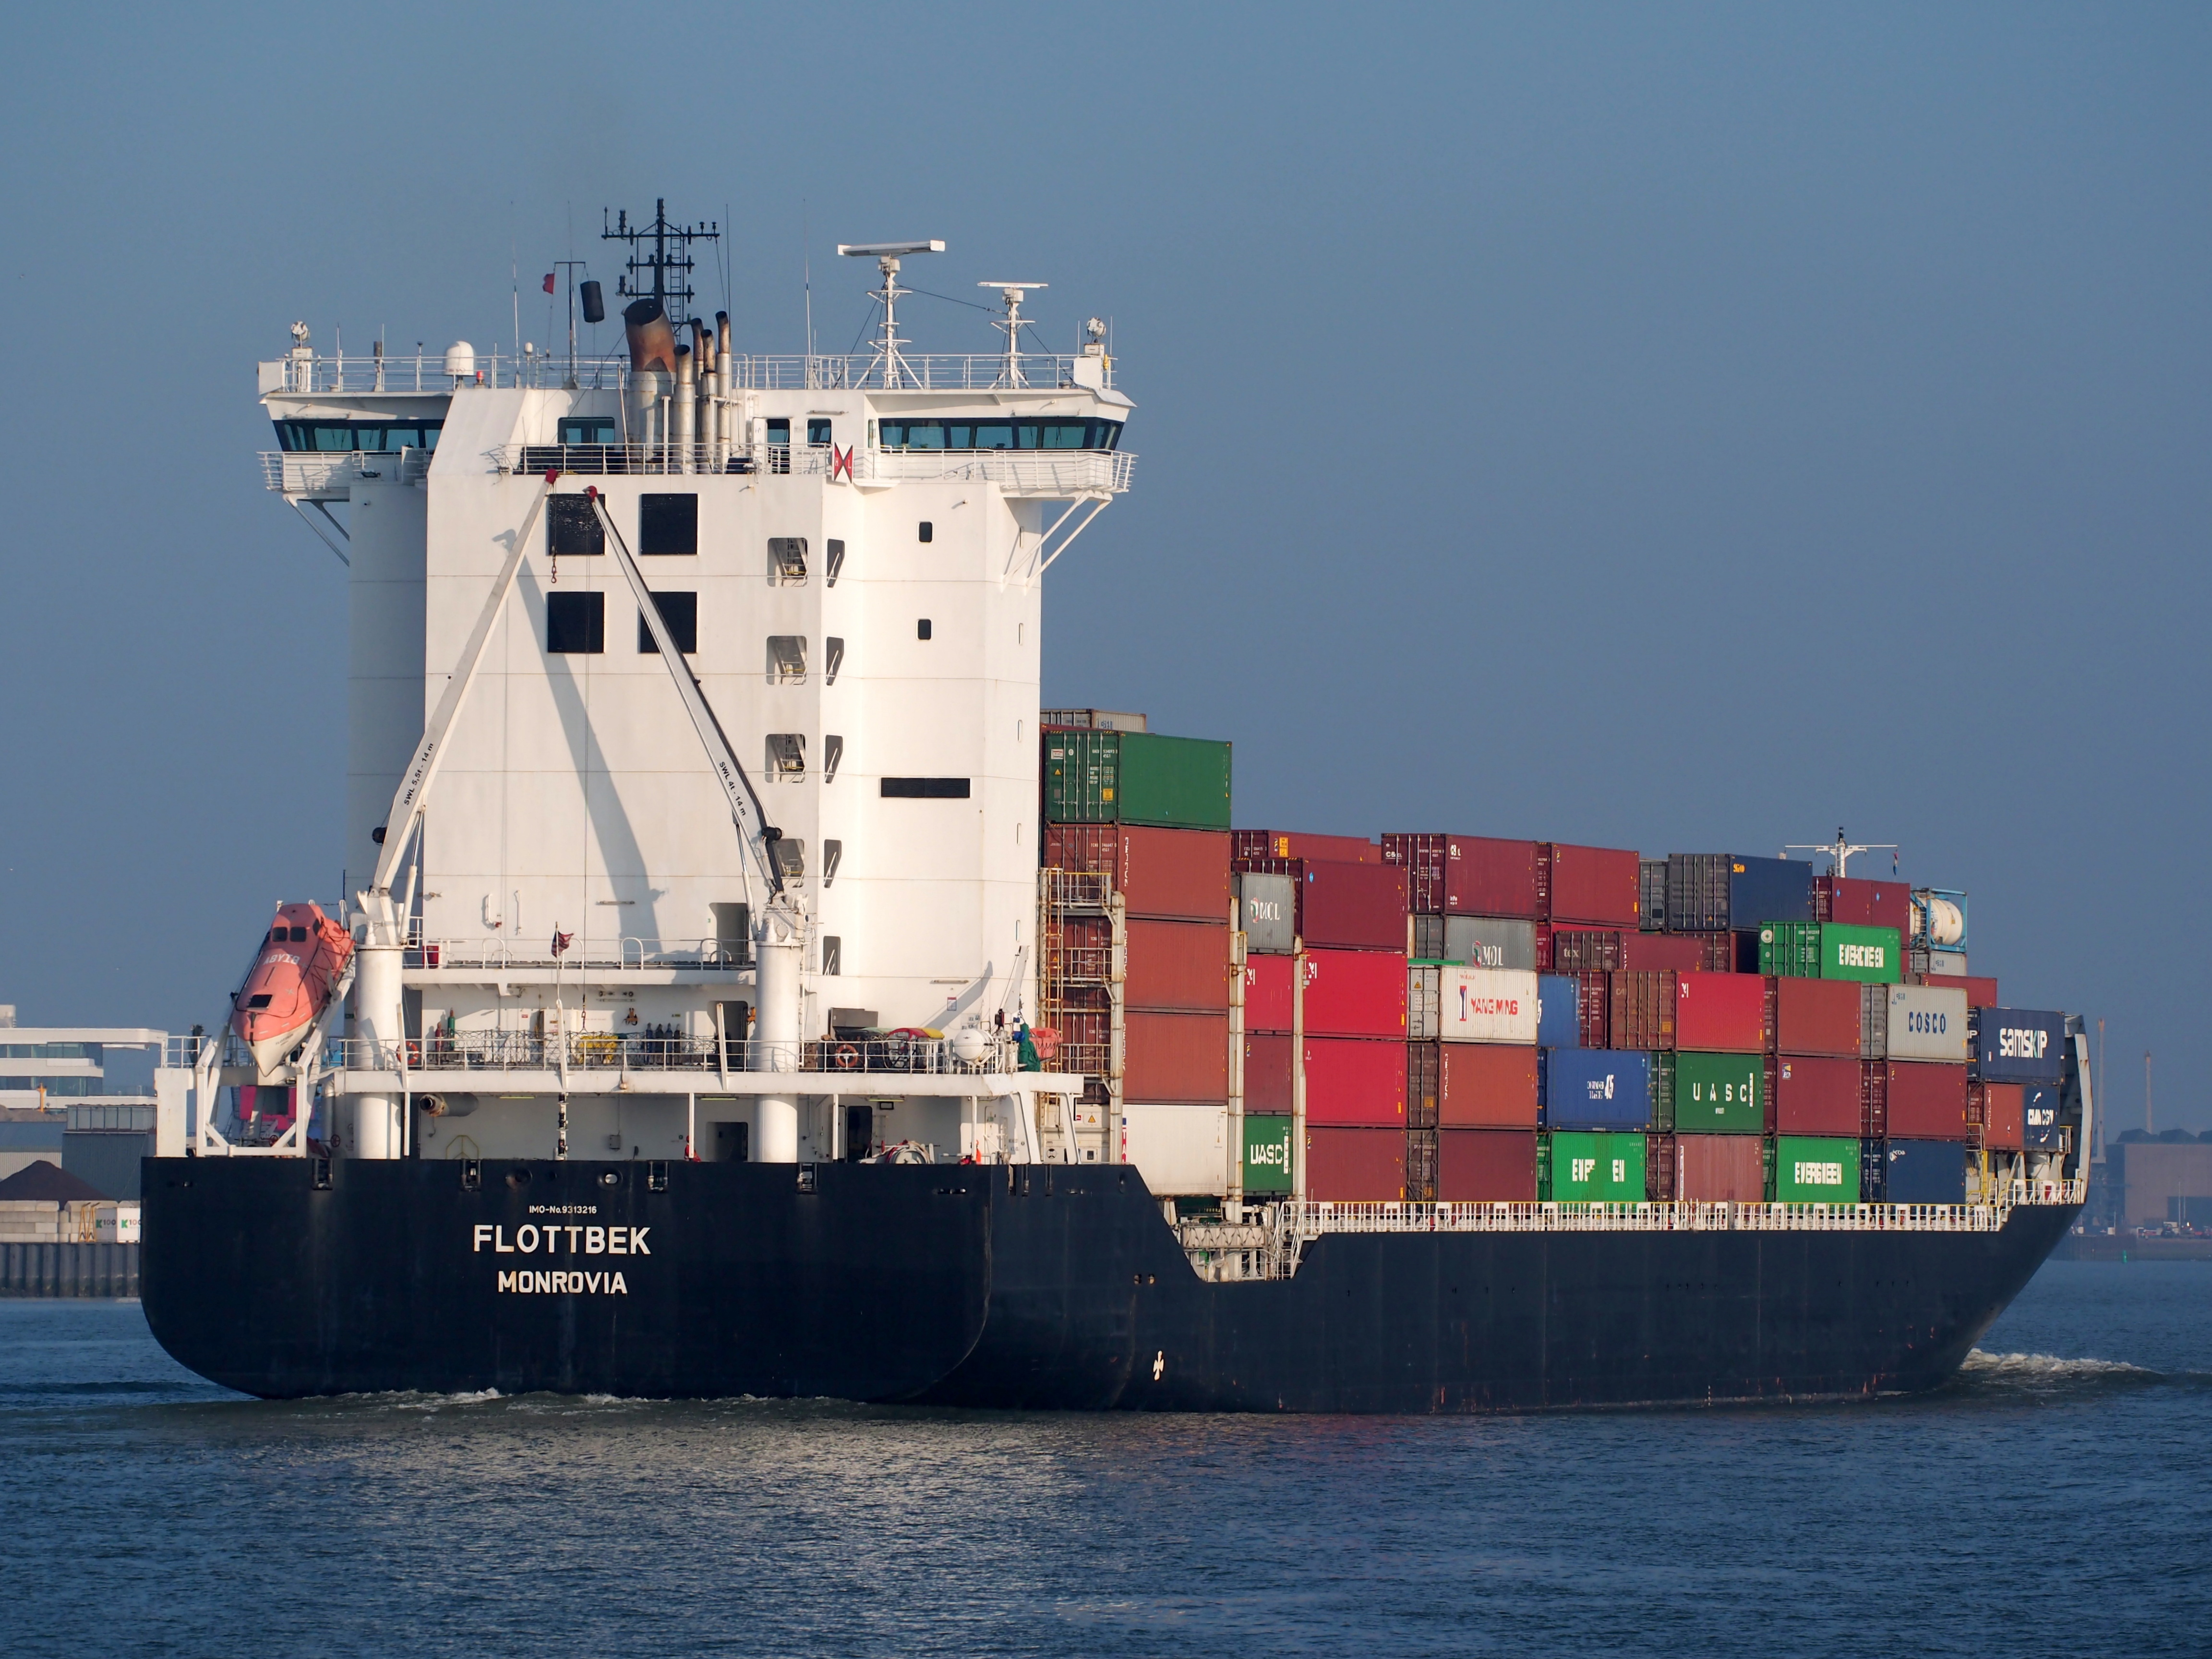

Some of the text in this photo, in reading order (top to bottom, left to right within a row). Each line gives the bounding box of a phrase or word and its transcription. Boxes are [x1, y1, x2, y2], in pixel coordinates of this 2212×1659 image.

[404, 788, 414, 805] SWL
[412, 769, 422, 785] 5,5t
[422, 753, 429, 761] 14
[428, 743, 433, 751] m
[720, 762, 730, 780] SWL
[729, 781, 735, 790] 4t
[735, 796, 743, 806] 14
[1563, 948, 1579, 958] tex
[1839, 944, 1884, 968] EVERGREEN
[1471, 998, 1518, 1015] YANG MING
[1909, 1011, 1946, 1034] COSCO
[2028, 1109, 2041, 1125] CMA
[1250, 1144, 1283, 1164] UASC
[1794, 1162, 1842, 1185] EVERGREEN
[529, 1205, 597, 1214] IMO-No.9313216
[474, 1224, 651, 1254] FLOTTBEK
[498, 1271, 627, 1294] MONROVIA
